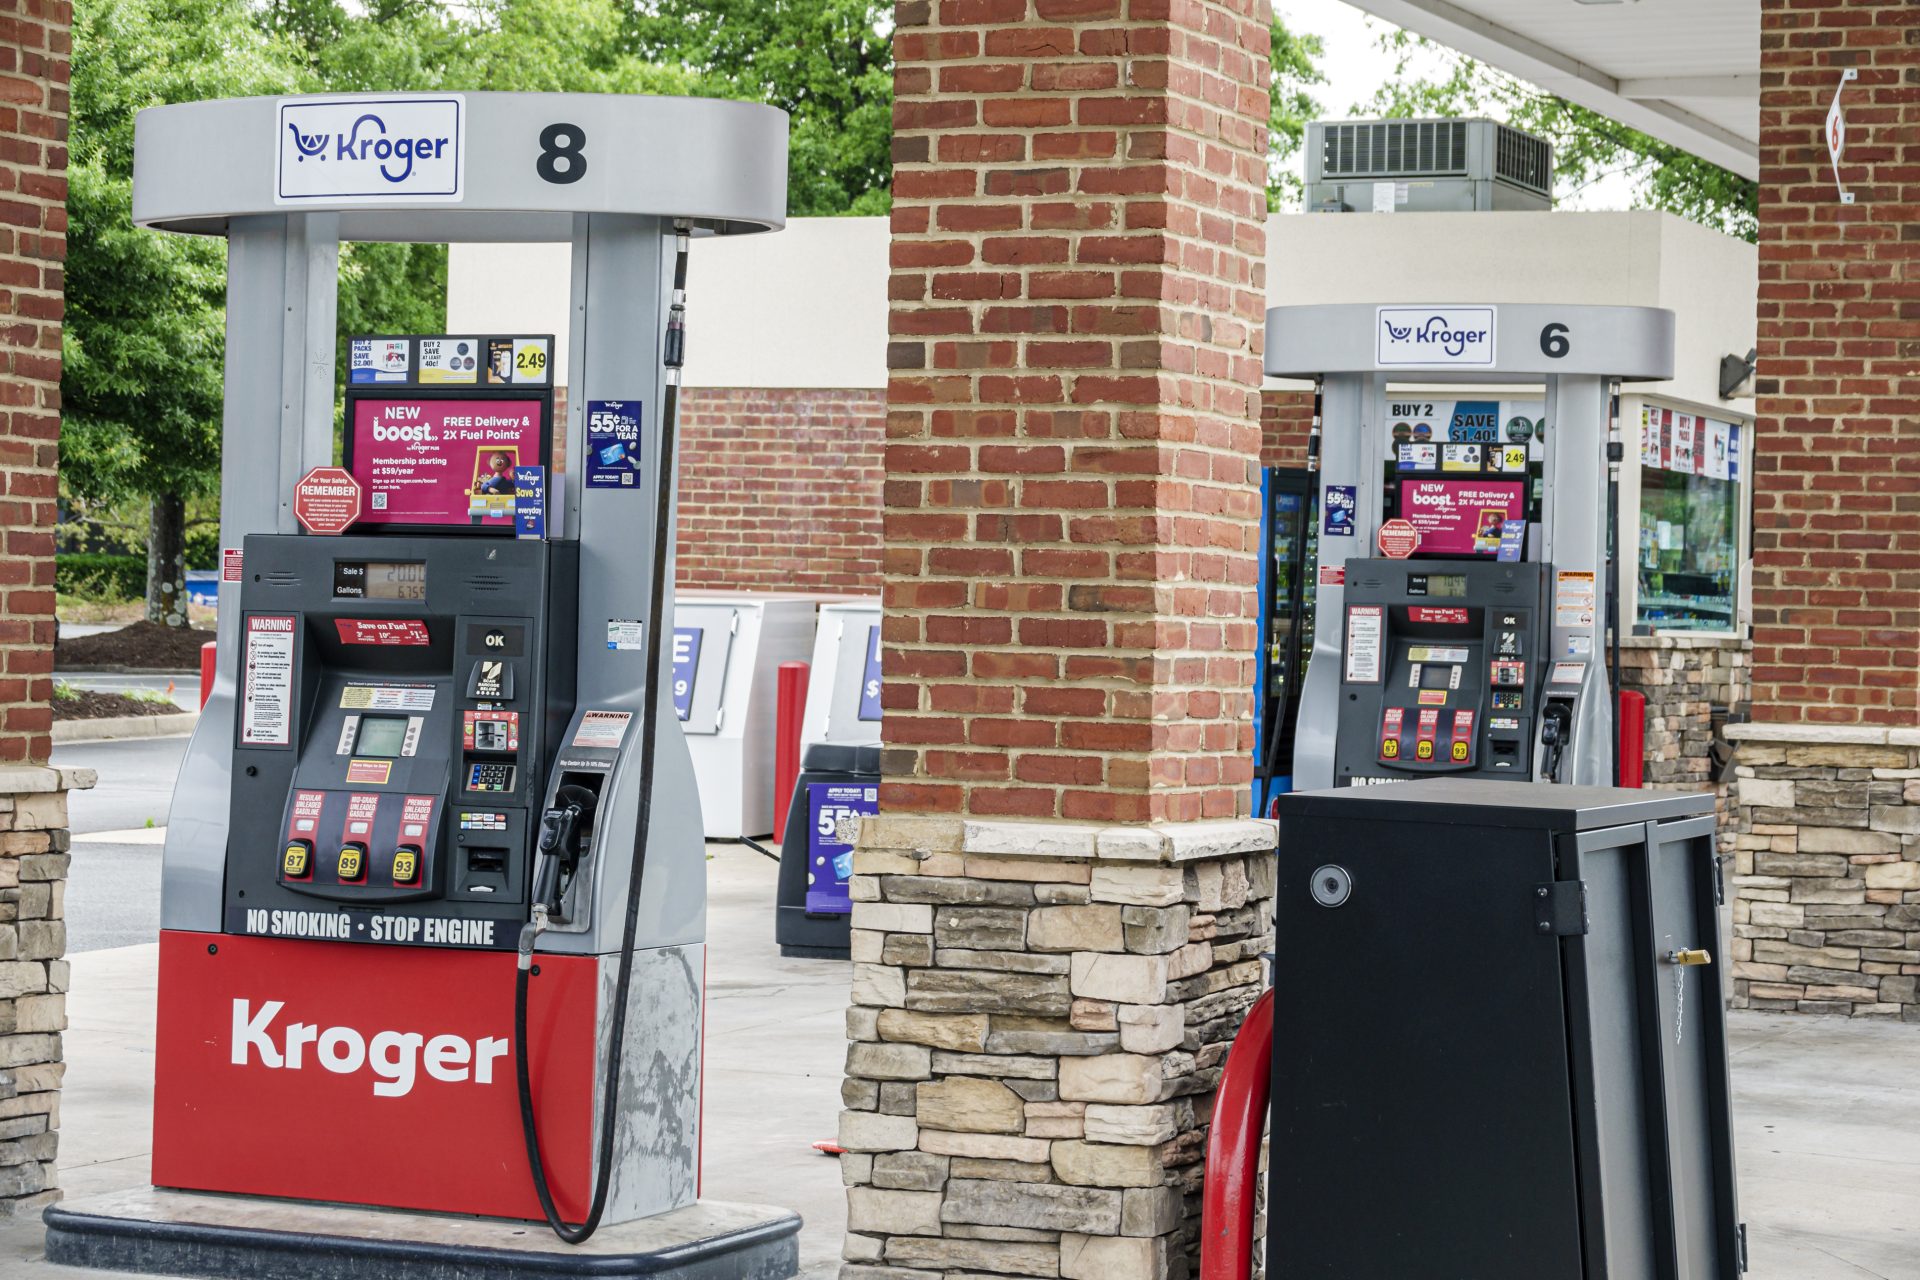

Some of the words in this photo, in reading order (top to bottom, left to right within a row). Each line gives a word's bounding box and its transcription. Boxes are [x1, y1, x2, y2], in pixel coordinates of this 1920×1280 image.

[1832, 115, 1839, 151] 6
[337, 114, 448, 182] Kroger
[536, 122, 588, 185] 8
[1416, 316, 1487, 356] Kroger
[1540, 322, 1570, 359] 6
[516, 353, 547, 369] 2.49
[385, 406, 421, 419] NEW
[1392, 404, 1421, 417] BUY
[1424, 404, 1433, 417] 2
[443, 416, 472, 427] FREE
[475, 416, 519, 428] Delivery
[522, 417, 530, 427] &
[590, 414, 621, 433] 55¢
[1454, 414, 1495, 428] SAVE
[373, 417, 431, 442] boost
[443, 430, 457, 440] 2X
[460, 430, 483, 440] Fuel
[616, 432, 637, 440] YEAR
[1452, 430, 1497, 442] $1.40!
[411, 442, 430, 454] Kroger
[372, 457, 417, 466] Membership
[418, 457, 447, 466] starting
[1505, 453, 1525, 463] 2.49
[382, 467, 414, 476] $59/year
[331, 477, 347, 485] Safety
[301, 485, 355, 497] REMEMBER
[515, 487, 533, 498] Save
[1421, 484, 1444, 492] NEW
[1412, 489, 1451, 505] boost
[1479, 491, 1508, 499] Delivery
[518, 507, 542, 516] everyday
[343, 567, 357, 575] Sale
[359, 567, 363, 576] $
[336, 586, 362, 595] Gallons
[1351, 607, 1380, 616] WARNING
[251, 618, 292, 632] WARNING
[388, 622, 407, 630] Fuel
[1503, 616, 1516, 625] OK
[485, 635, 504, 647] OK
[298, 793, 322, 801] REGULAR
[407, 799, 432, 807] PREMIUM
[296, 801, 322, 809] UNLEADED
[349, 803, 376, 811] UNLEADED
[404, 806, 430, 814] UNLEADED
[294, 808, 319, 816] GASOLINE
[349, 810, 374, 818] GASOLINE
[403, 813, 428, 821] GASOLINE
[287, 855, 304, 867] 87
[340, 857, 358, 870] 89
[395, 860, 412, 873] 93
[247, 909, 268, 934] NO
[271, 911, 350, 938] SMOKING
[370, 915, 420, 942] STOP
[423, 918, 494, 945] ENGINE
[231, 998, 508, 1097] Kroger
